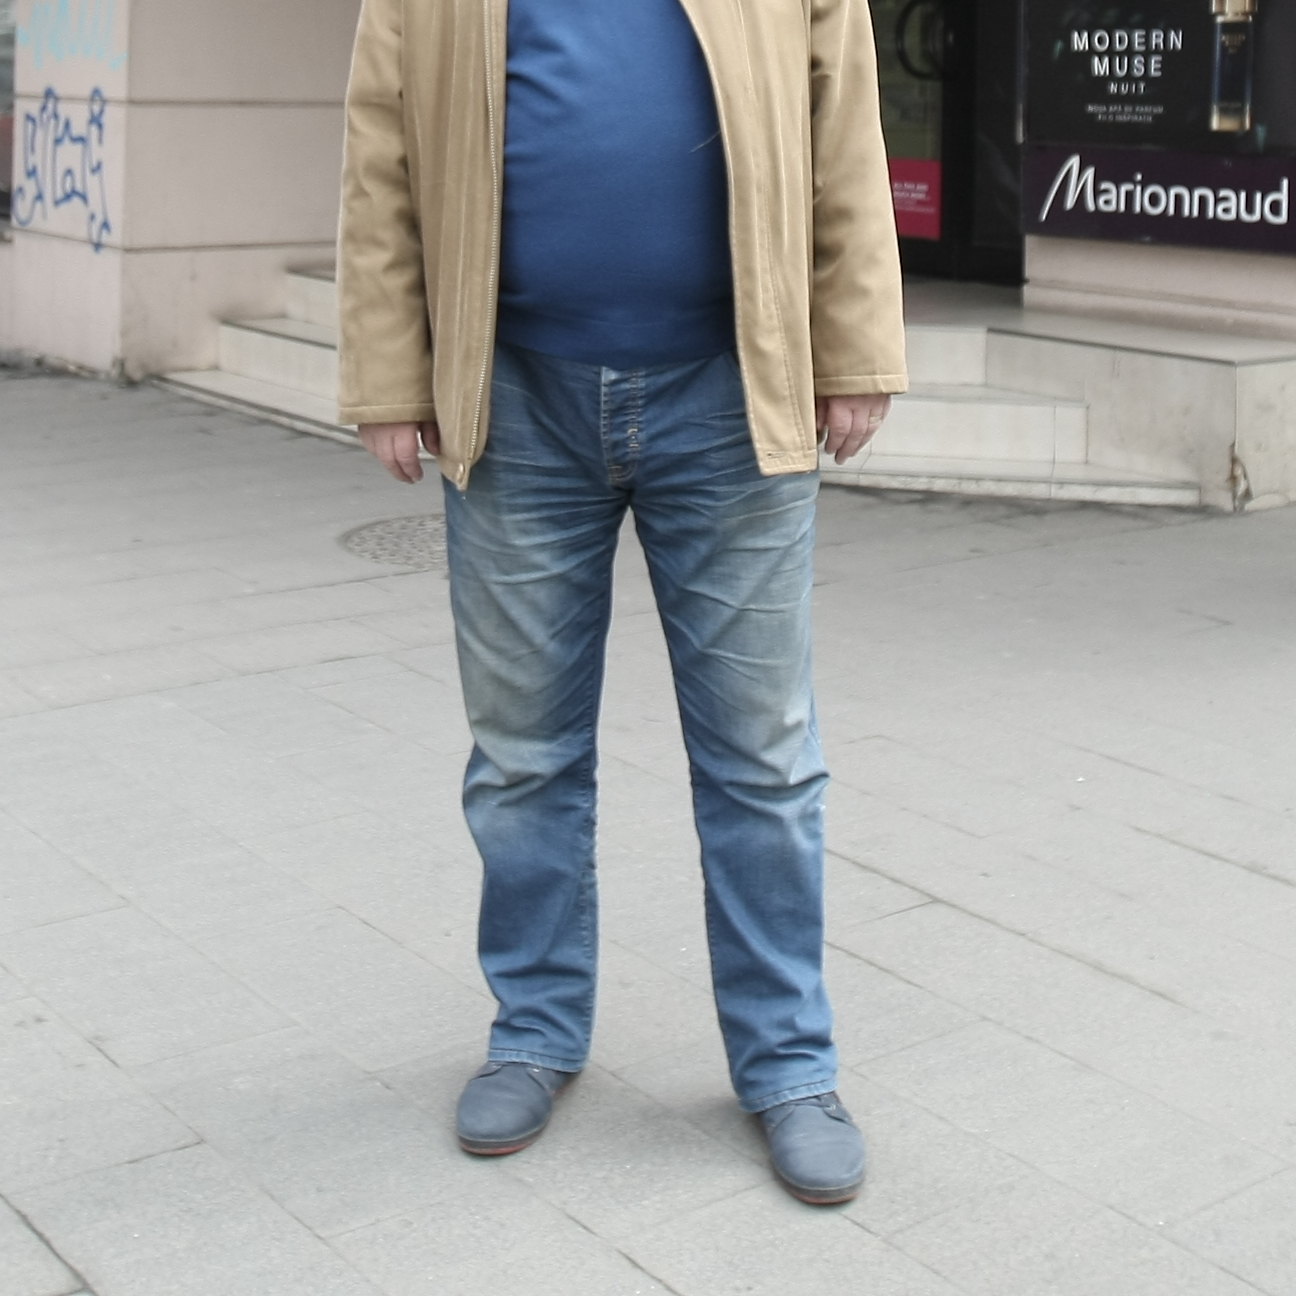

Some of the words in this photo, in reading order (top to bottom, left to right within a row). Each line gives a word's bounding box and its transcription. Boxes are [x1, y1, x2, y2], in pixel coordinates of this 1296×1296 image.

[1071, 29, 1183, 52] MODERN
[1091, 54, 1163, 78] MUSE
[1107, 81, 1147, 95] NUIT
[1039, 154, 1289, 225] Marionnaud
